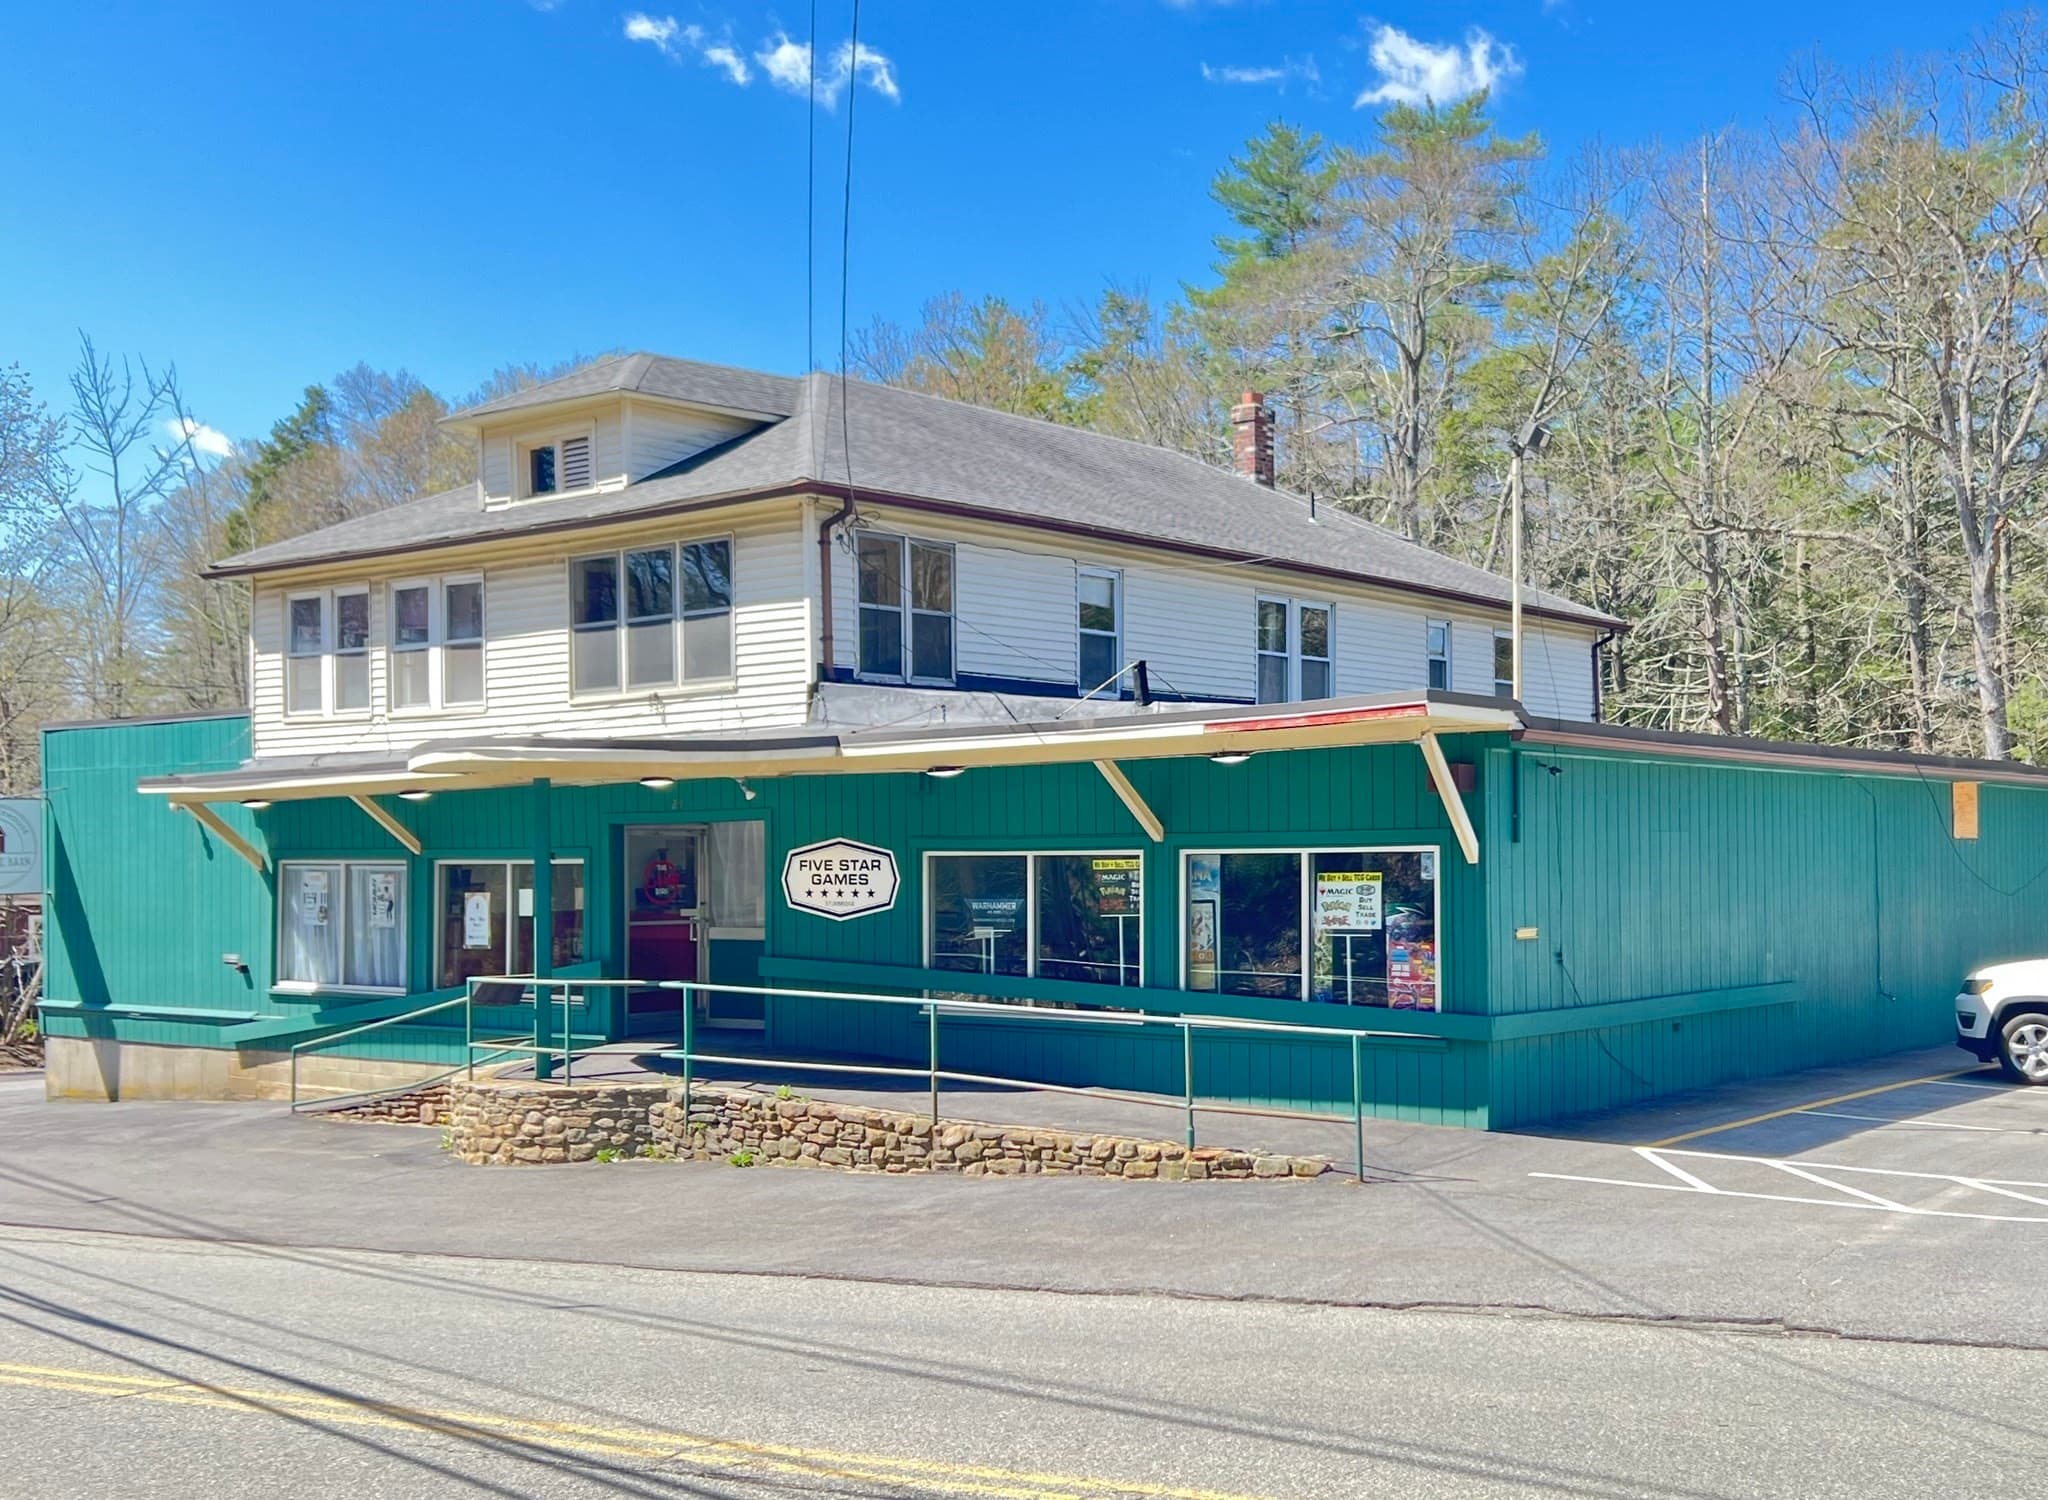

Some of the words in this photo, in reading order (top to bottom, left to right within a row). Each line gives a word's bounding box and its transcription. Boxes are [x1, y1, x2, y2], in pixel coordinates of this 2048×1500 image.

[799, 860, 833, 871] FIVE
[839, 860, 881, 871] STAR
[811, 874, 869, 885] GAMES
[972, 902, 1016, 910] WARHAMMER
